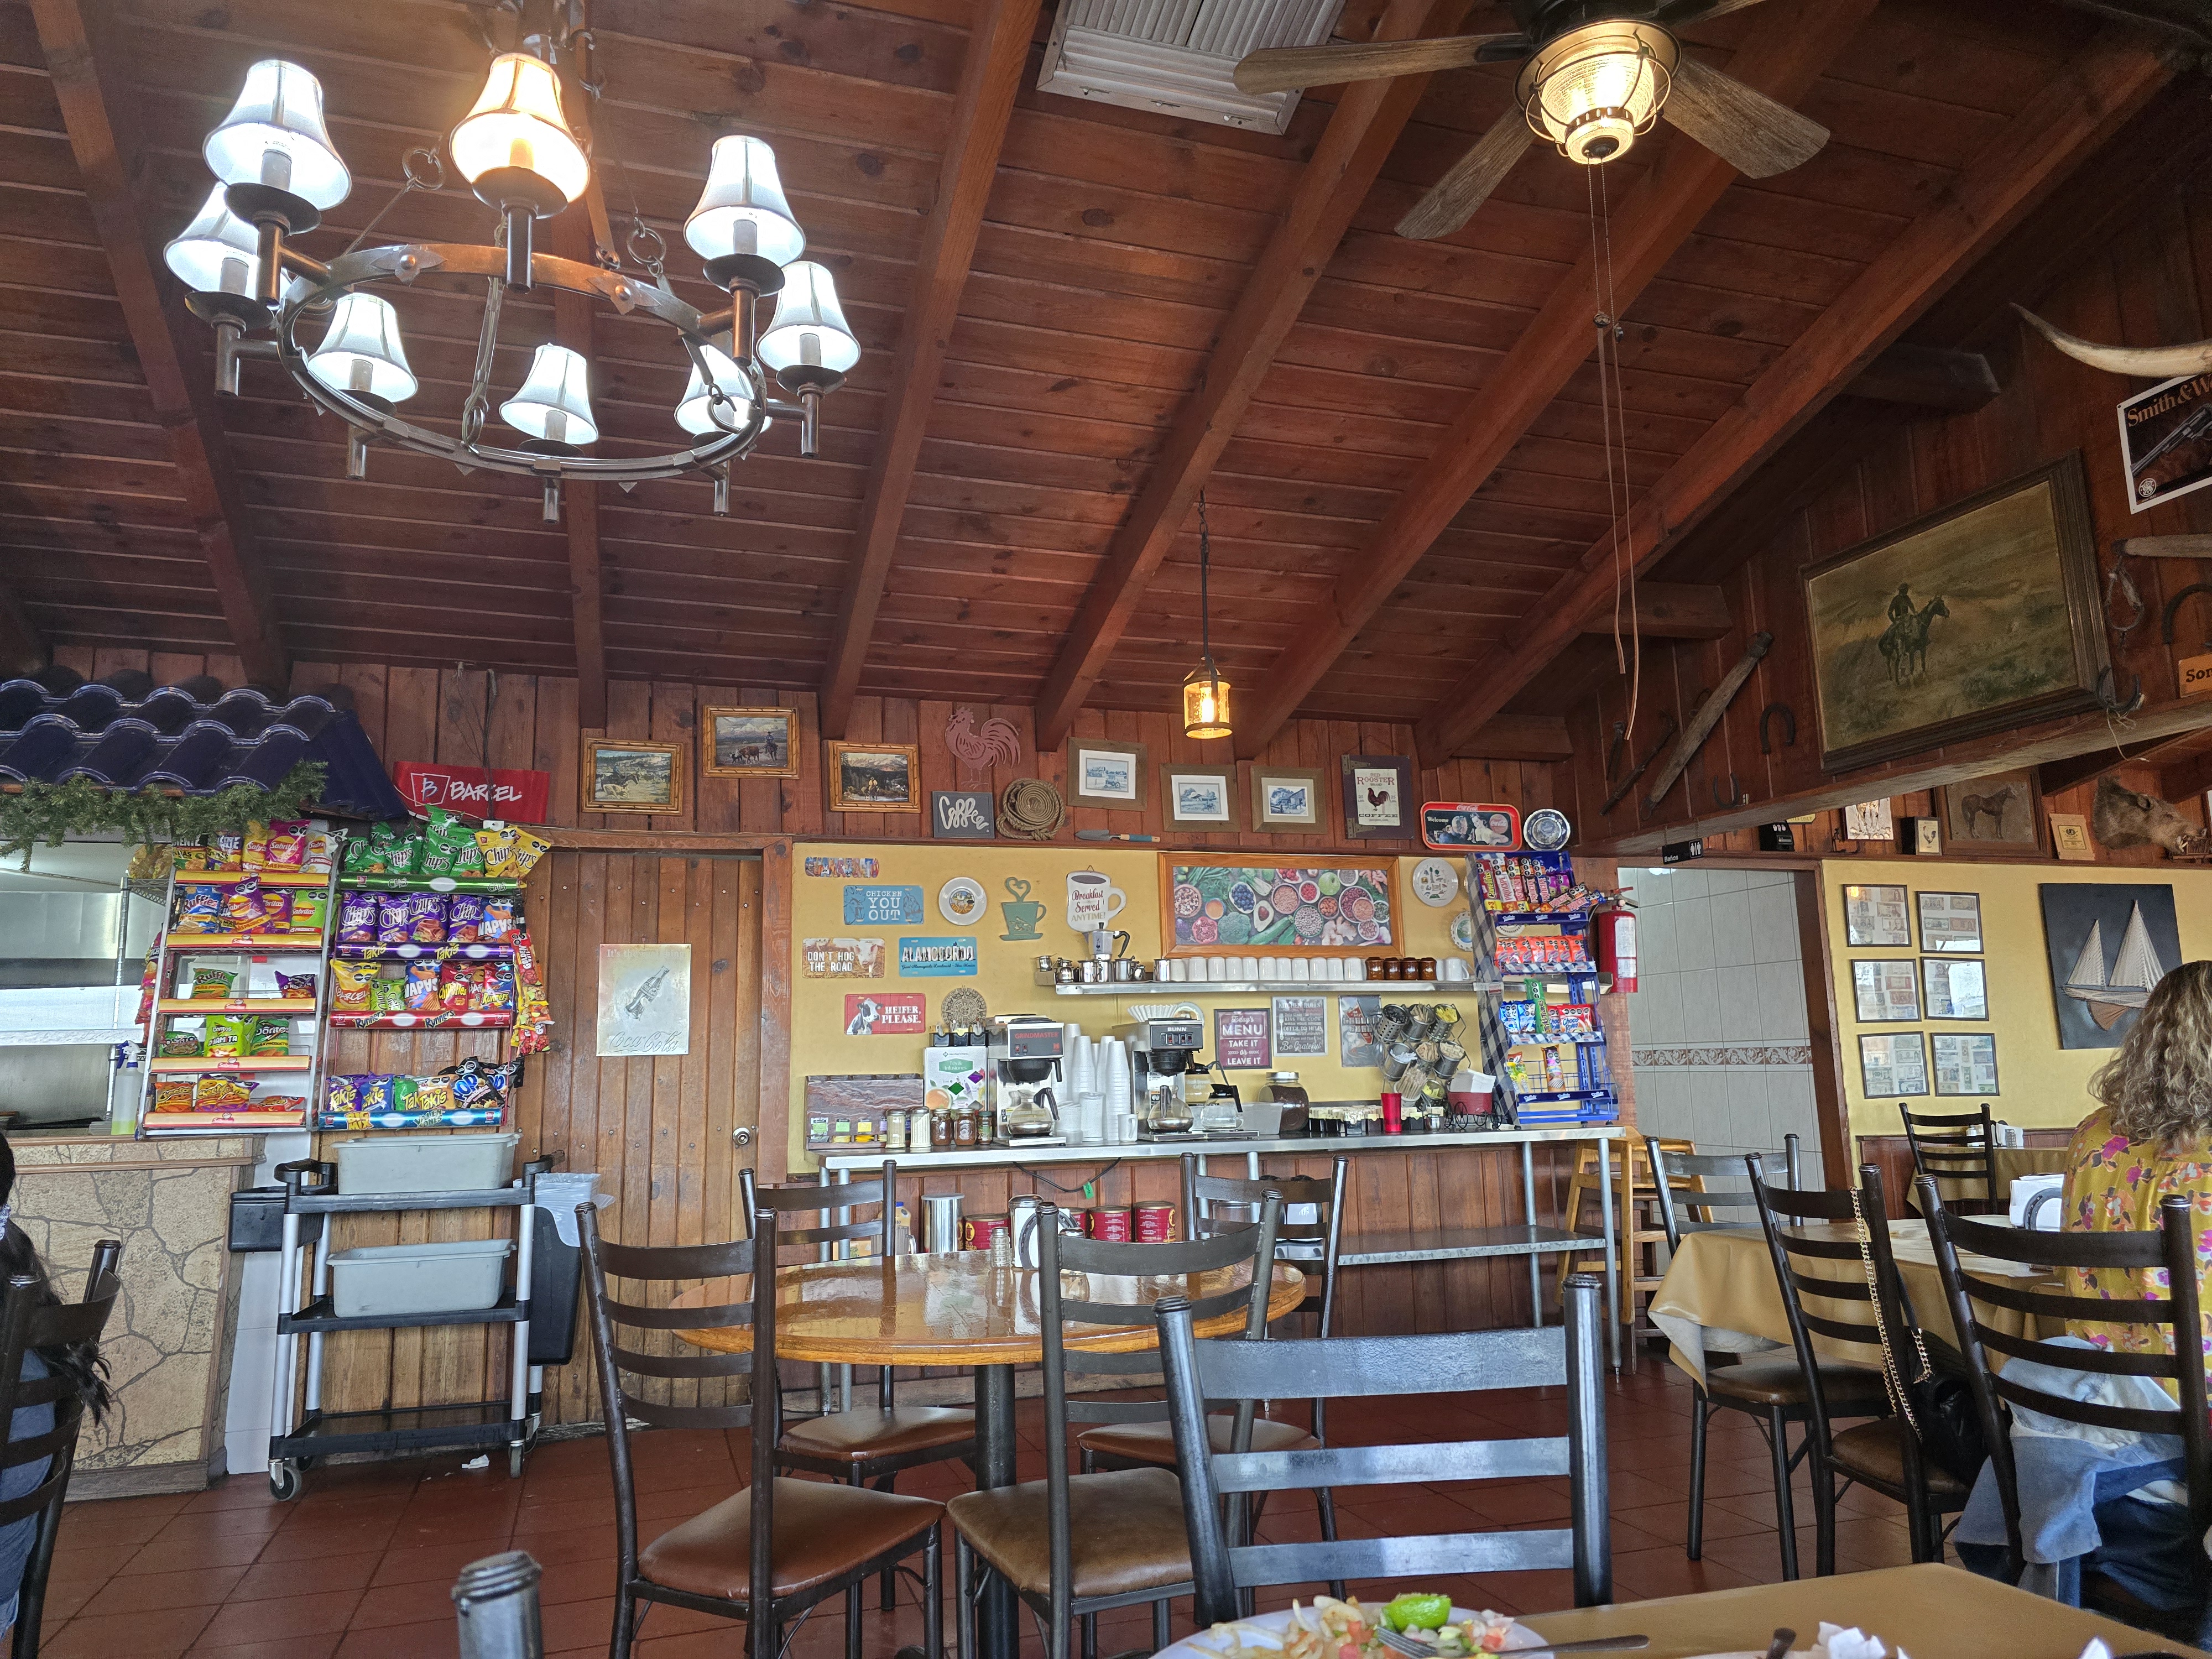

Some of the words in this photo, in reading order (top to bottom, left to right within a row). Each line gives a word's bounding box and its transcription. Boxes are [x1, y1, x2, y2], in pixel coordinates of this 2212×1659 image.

[2127, 393, 2176, 427] Smith
[2177, 384, 2194, 404] &
[1357, 776, 1395, 785] ROOSTER
[269, 842, 299, 851] Sabritas
[424, 852, 450, 871] hip's
[455, 847, 484, 866] hip's
[517, 848, 537, 870] hip's
[1072, 888, 1104, 901] Breakfast
[182, 894, 218, 914] Ruffles
[409, 896, 441, 915] Chip's
[868, 897, 900, 909] YOU
[1075, 901, 1100, 912] Served
[342, 906, 376, 926] Chip's
[869, 909, 900, 921] OUT
[1071, 912, 1106, 922] ANYTIME!
[361, 942, 387, 960] Takis
[435, 942, 460, 960] Takis
[607, 949, 620, 957] It's
[807, 951, 832, 961] DON'T
[837, 951, 855, 961] HOG
[902, 945, 974, 962] ALAMOGORDO
[810, 962, 825, 972] THE
[831, 962, 853, 972] ROAD
[336, 988, 367, 1001] BARCEL
[481, 992, 509, 1006] Runners
[885, 1006, 922, 1015] HEIFER,
[354, 1010, 386, 1029] Runners
[424, 1010, 455, 1029] Runners
[881, 1014, 922, 1024] PLEASE.
[1231, 1015, 1254, 1024] Today's
[1222, 1024, 1264, 1036] MENU
[609, 1031, 682, 1053] Coca-Cola
[1280, 1041, 1293, 1051] Be
[1294, 1041, 1321, 1052] Grateful
[330, 1086, 358, 1105] Takis
[403, 1092, 419, 1110] Tak
[419, 1088, 447, 1110] Takis
[346, 1112, 369, 1121] BIG
[348, 1120, 374, 1130] MIX
